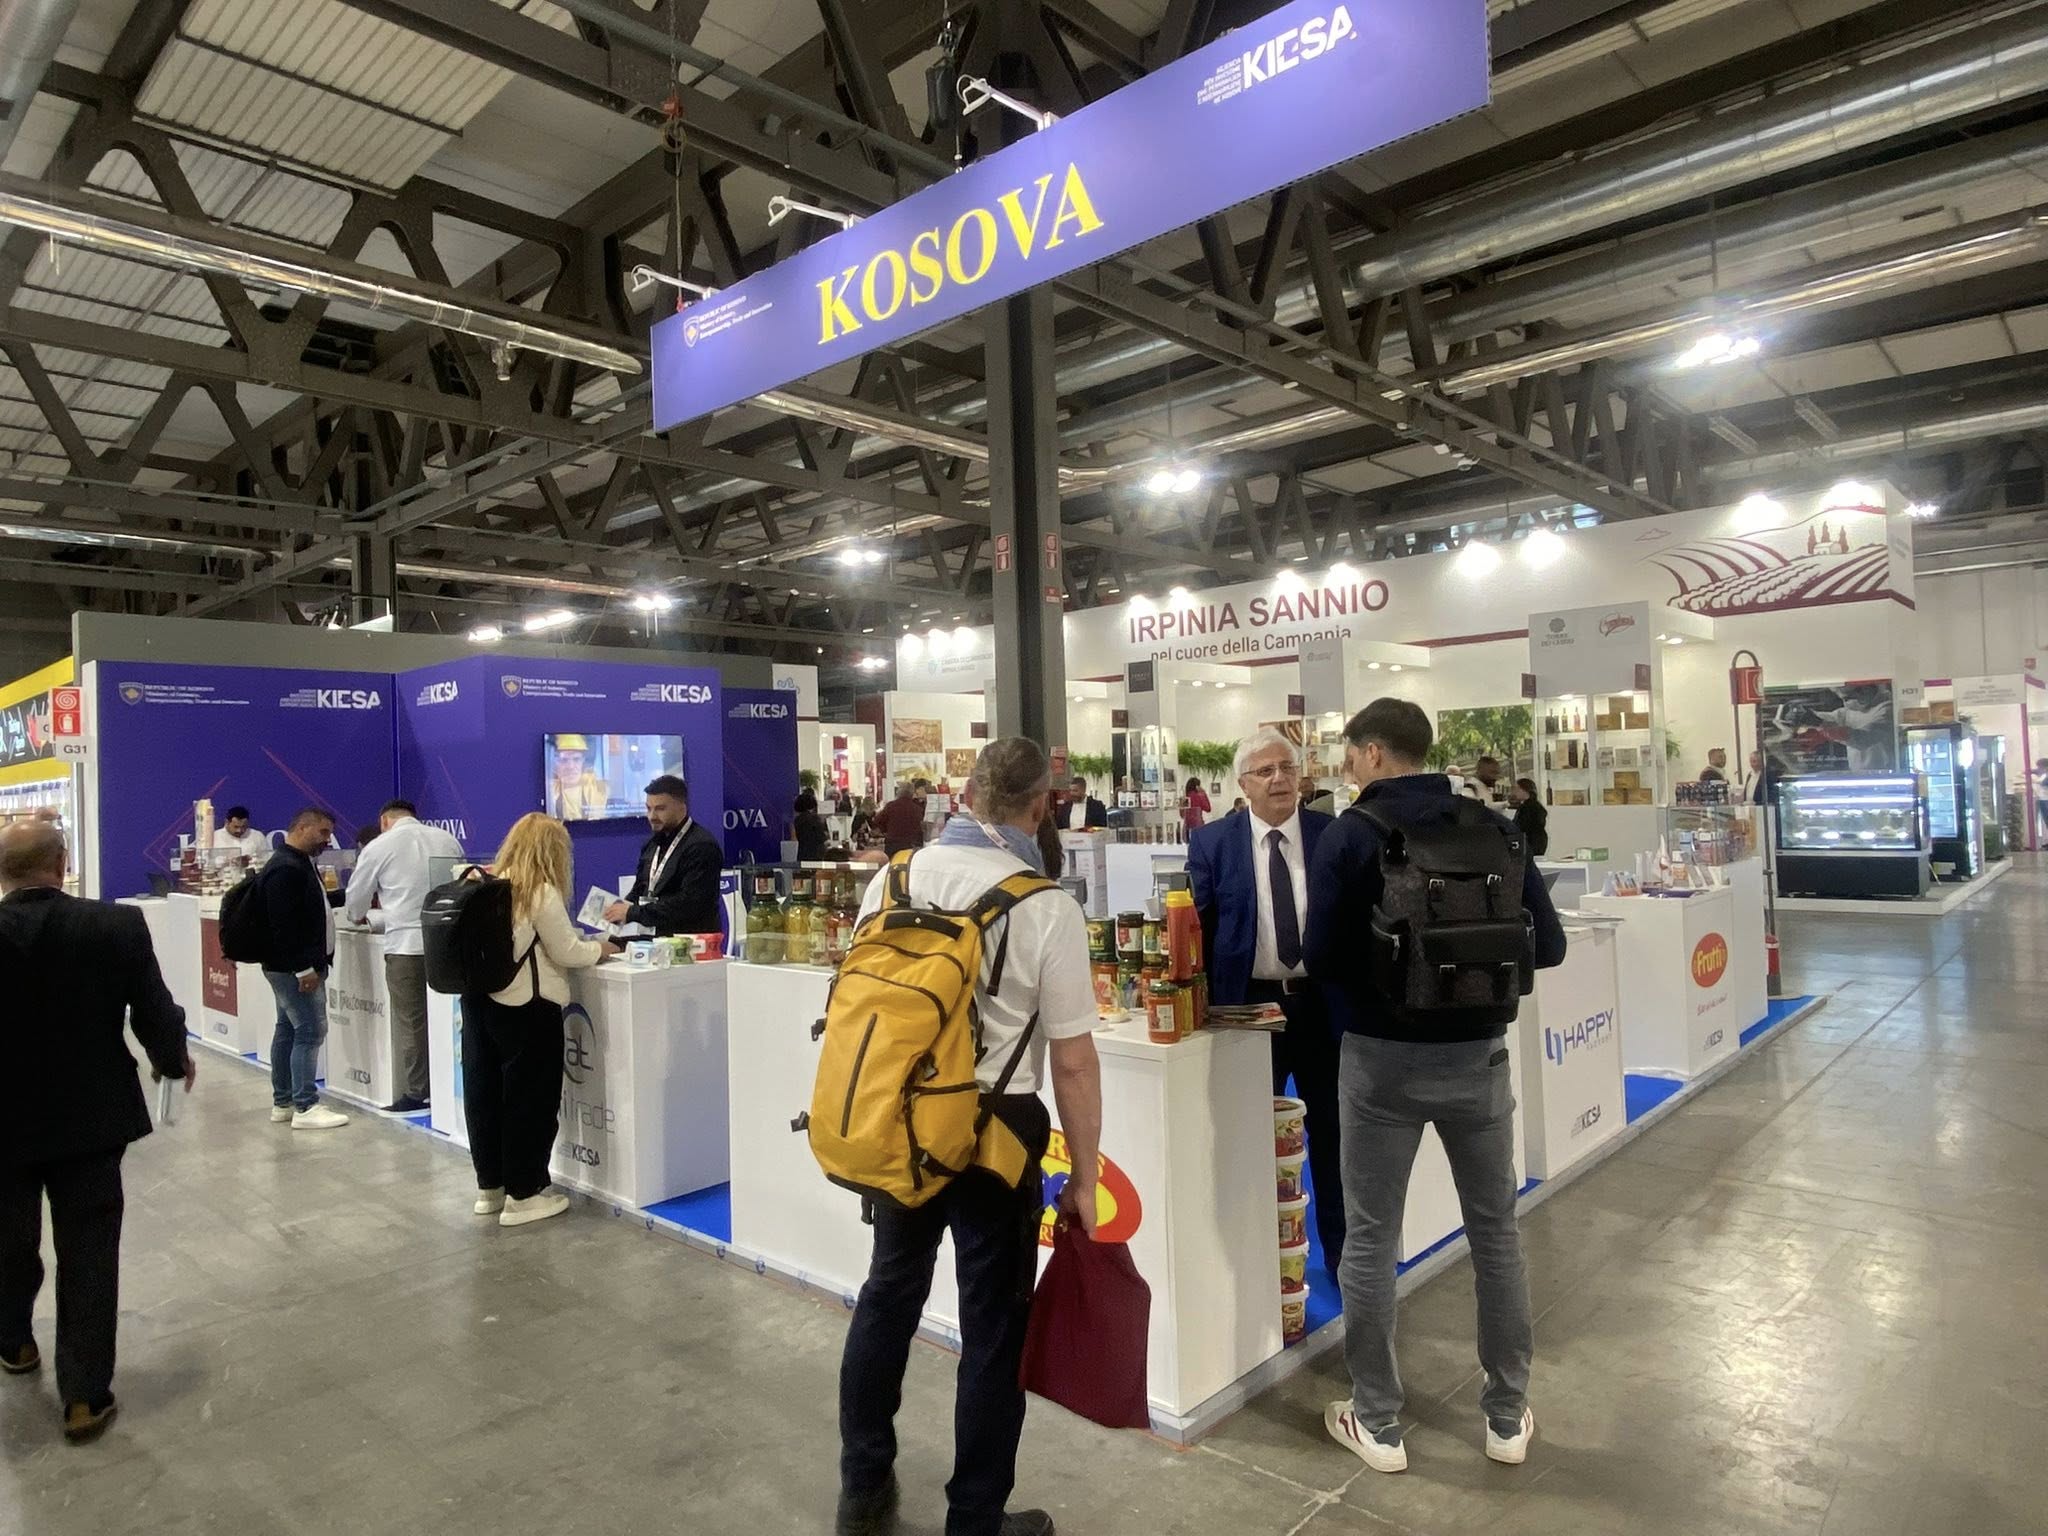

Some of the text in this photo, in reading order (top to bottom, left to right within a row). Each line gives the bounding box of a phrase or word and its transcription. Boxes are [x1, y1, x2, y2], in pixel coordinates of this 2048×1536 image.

[1242, 5, 1354, 89] KIESA
[816, 162, 1105, 345] KOSOVA
[1130, 579, 1390, 644] IRPINIA SANNIO
[1151, 647, 1172, 661] nel
[1175, 643, 1218, 661] cuore
[1223, 635, 1260, 656] della
[317, 688, 381, 710] KIESA
[430, 680, 459, 704] KIESA
[660, 683, 713, 704] KIESA
[750, 703, 789, 719] KIESA
[63, 744, 88, 754] G31
[723, 809, 769, 830] OVA
[1563, 1008, 1614, 1054] HAPPY
